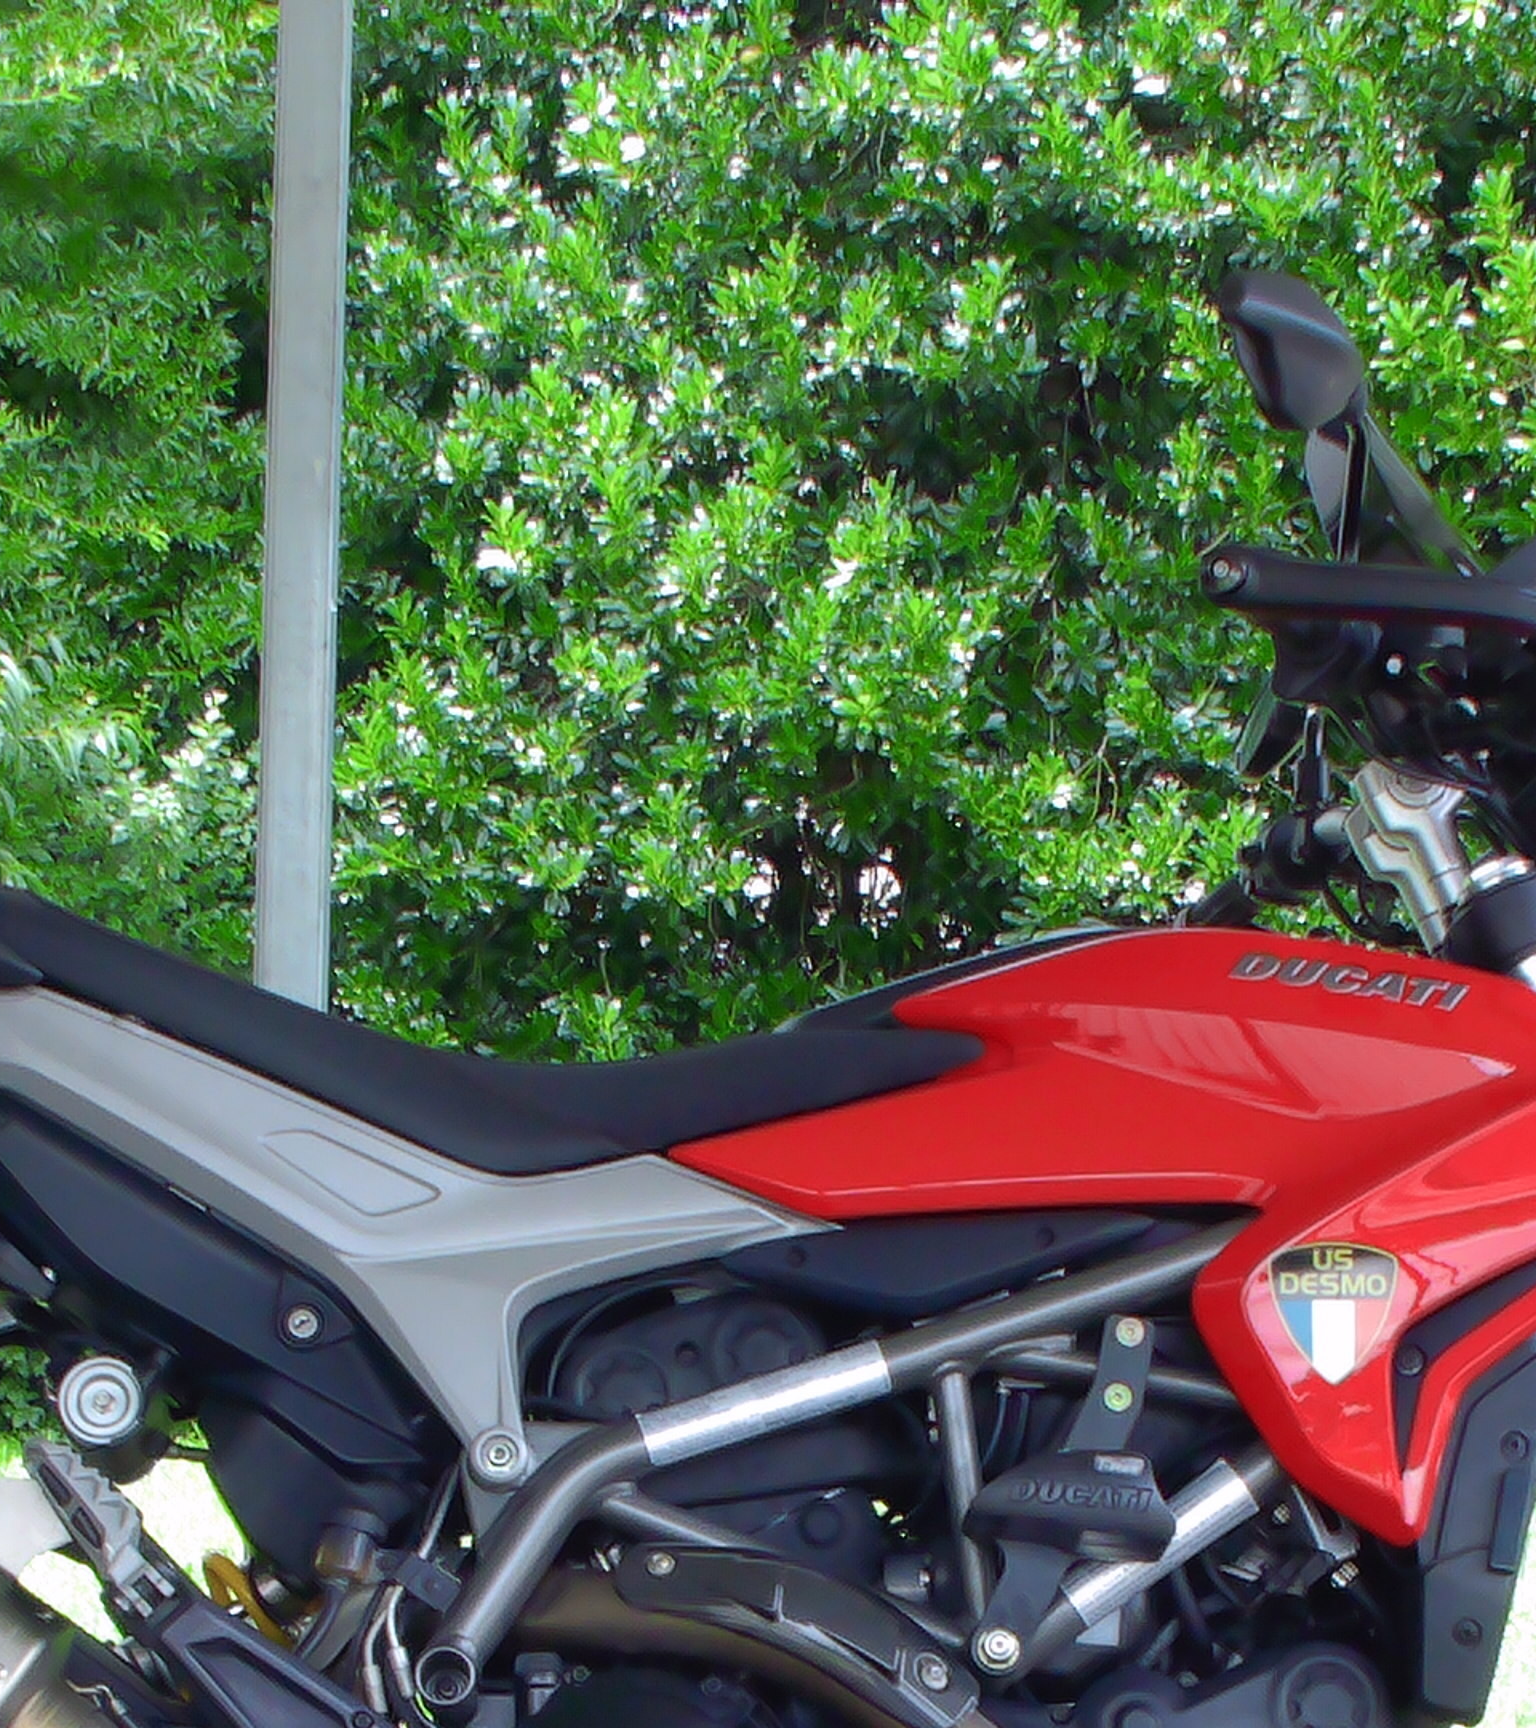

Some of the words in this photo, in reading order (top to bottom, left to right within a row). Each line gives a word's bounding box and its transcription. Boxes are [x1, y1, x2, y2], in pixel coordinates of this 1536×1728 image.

[1228, 952, 1469, 1012] DUCATI
[1312, 1248, 1355, 1272] US
[1279, 1272, 1387, 1297] DESMO
[1012, 1478, 1154, 1512] DUCATI
